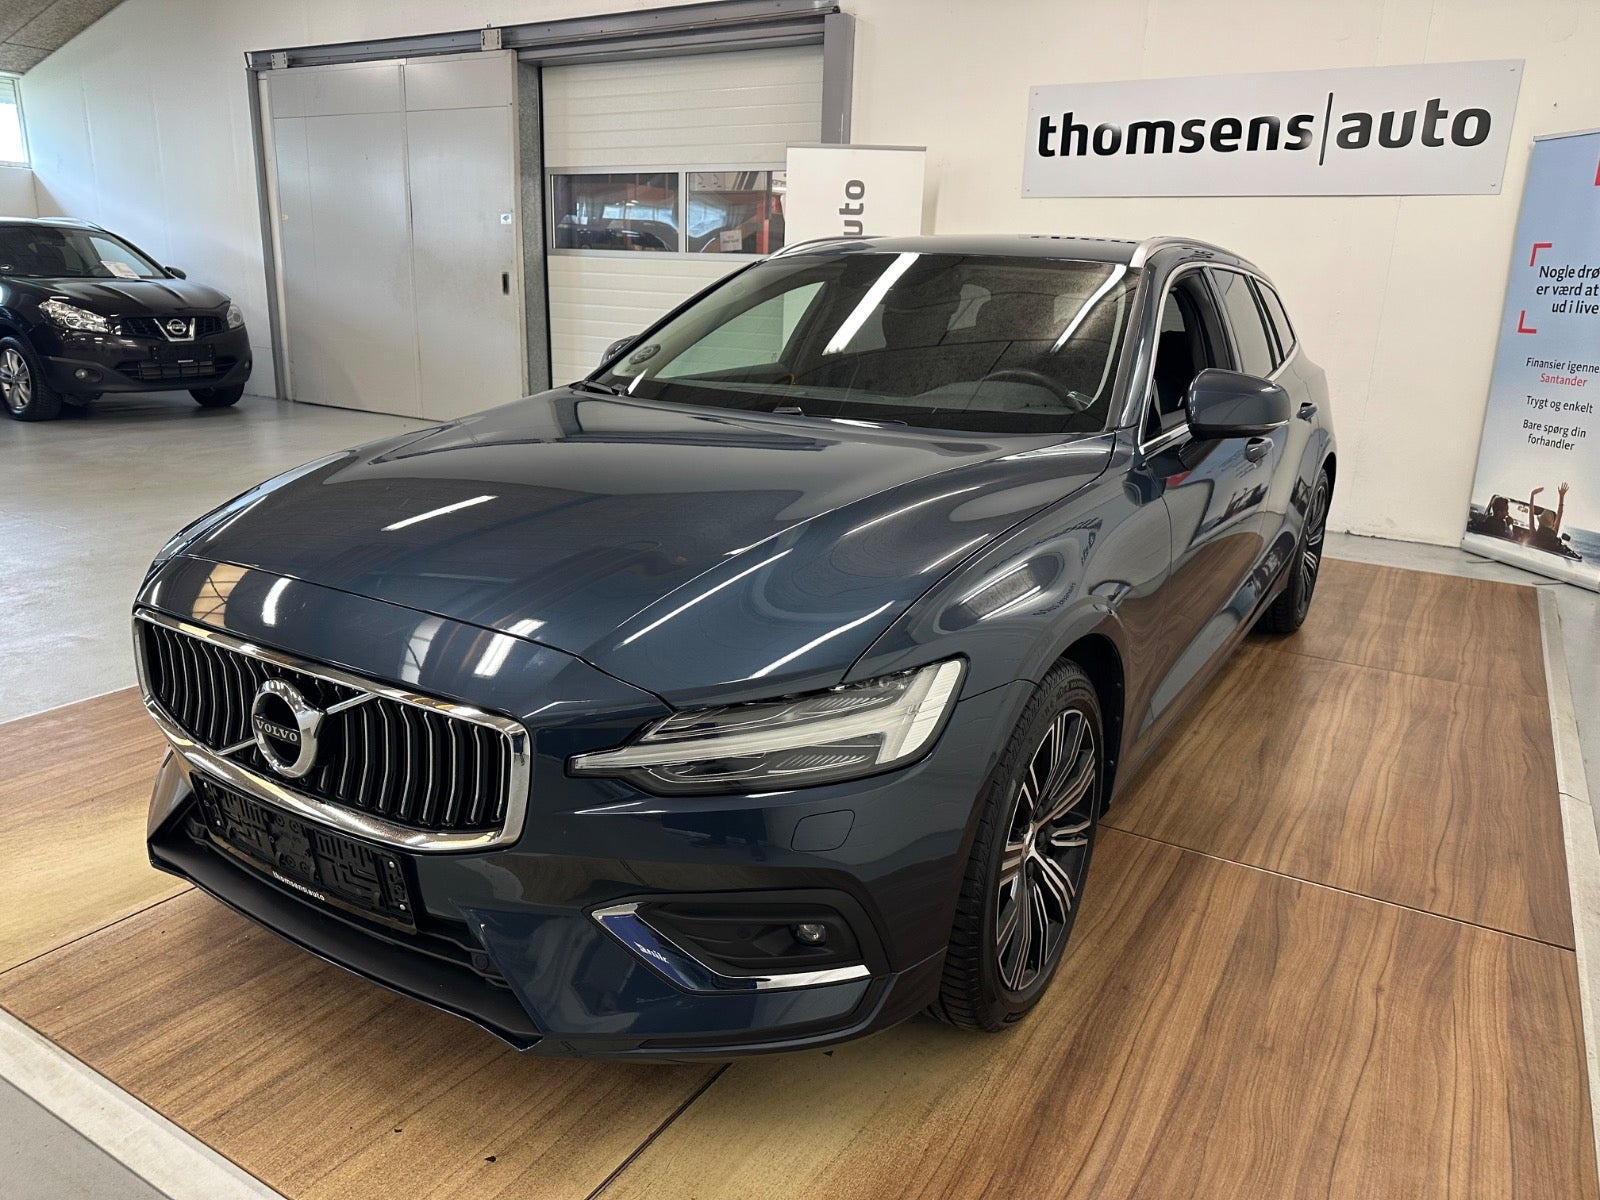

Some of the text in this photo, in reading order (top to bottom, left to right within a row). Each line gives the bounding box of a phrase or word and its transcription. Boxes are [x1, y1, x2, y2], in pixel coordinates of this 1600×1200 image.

[838, 179, 866, 236] uto
[1539, 264, 1600, 282] Nogle drø
[1536, 282, 1600, 297] er værd at
[1551, 299, 1600, 315] ud i live
[1525, 357, 1600, 374] Finansier igenne
[1540, 372, 1588, 388] Santander
[1526, 395, 1594, 414] Trygt og enkelt
[1522, 419, 1587, 439] Bare spørg din
[1527, 433, 1575, 451] forhandler
[255, 719, 298, 742] VOLVO
